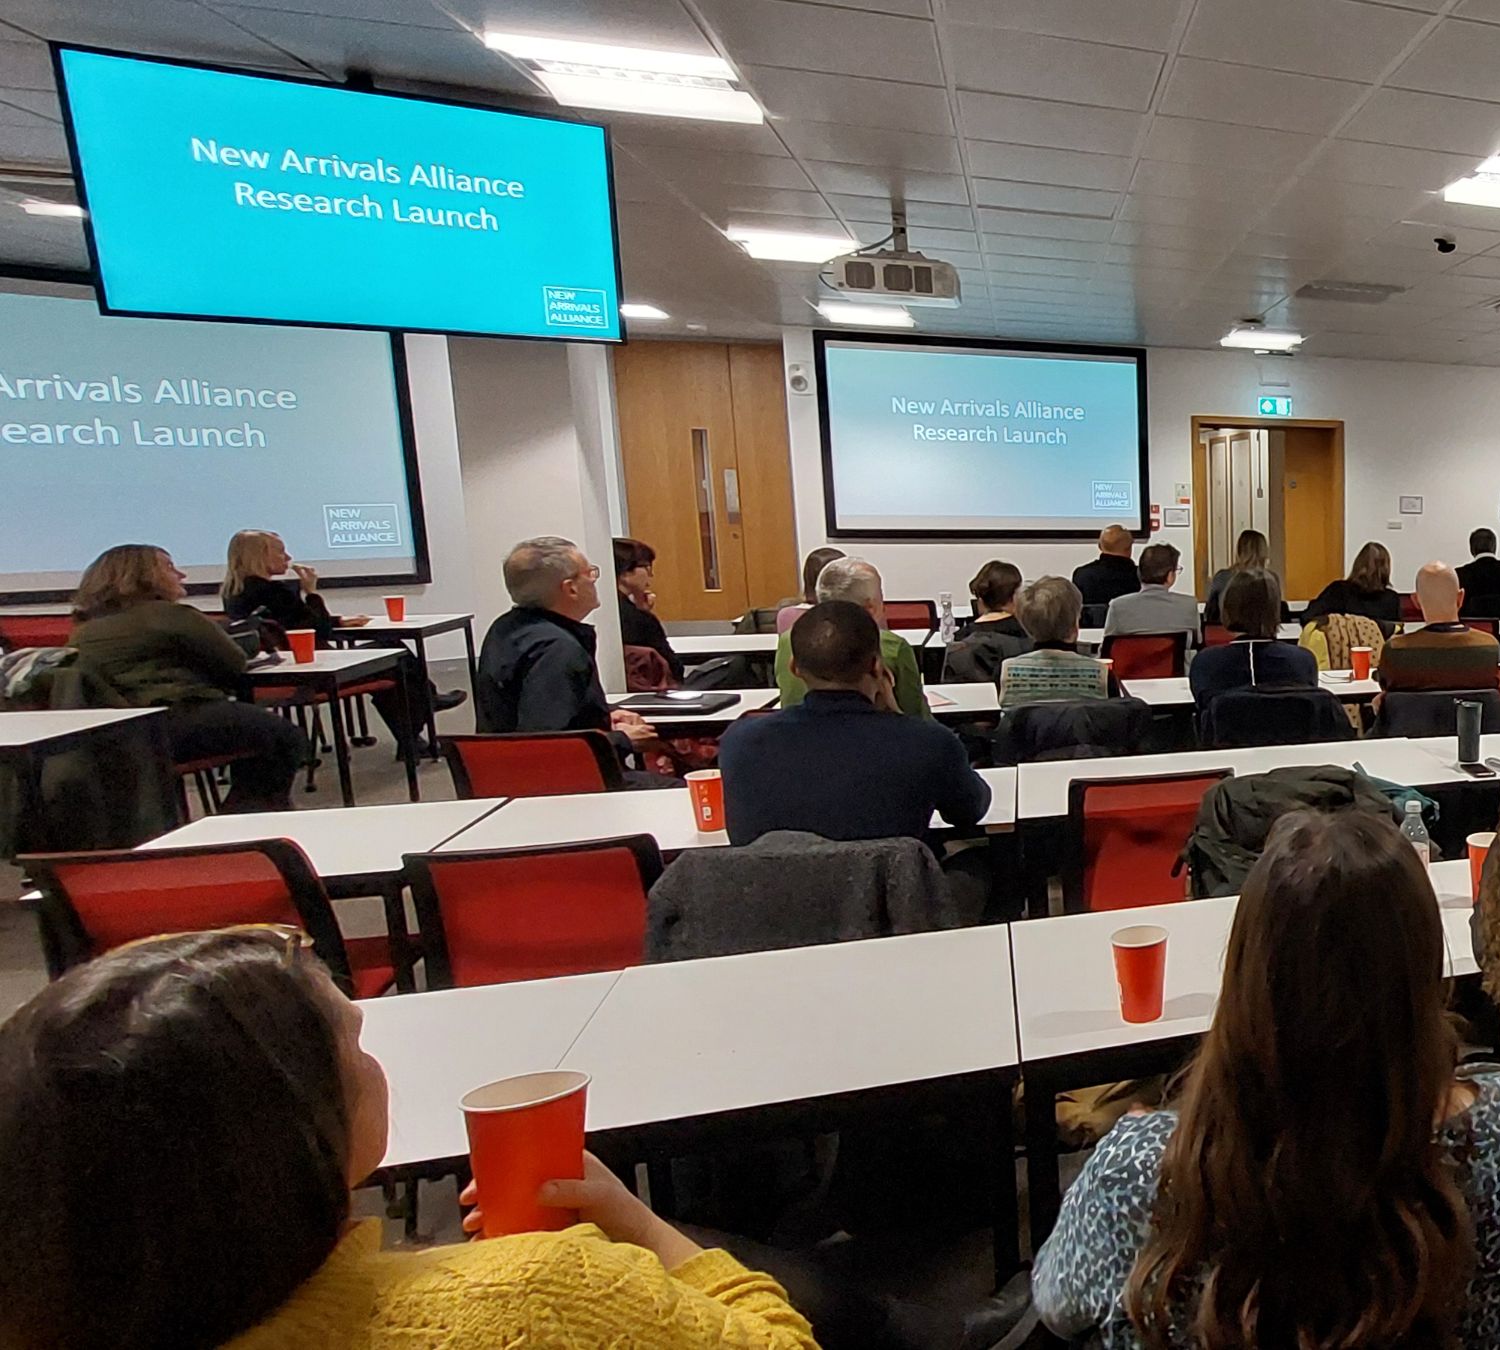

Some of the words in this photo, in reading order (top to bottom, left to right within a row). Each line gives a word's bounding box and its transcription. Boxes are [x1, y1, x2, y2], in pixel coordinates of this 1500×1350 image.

[190, 138, 269, 169] New
[280, 149, 401, 184] Arrivals
[409, 164, 525, 198] Alliance
[234, 182, 383, 219] Research
[393, 199, 500, 232] Launch
[548, 290, 576, 300] NEW
[549, 301, 600, 313] ARRIVALS
[550, 313, 604, 324] ALLIANCE
[154, 379, 297, 409] Alliance
[891, 397, 936, 414] New
[940, 399, 1010, 418] Arrivals
[1014, 401, 1085, 420] Alliance
[133, 420, 266, 448] Launch
[913, 424, 998, 442] Research
[1003, 427, 1067, 445] Launch
[1095, 491, 1128, 499] ARRIVALS
[329, 508, 361, 518] NEW
[331, 520, 391, 530] ARRIVALS
[332, 532, 396, 543] ALLIANCE
